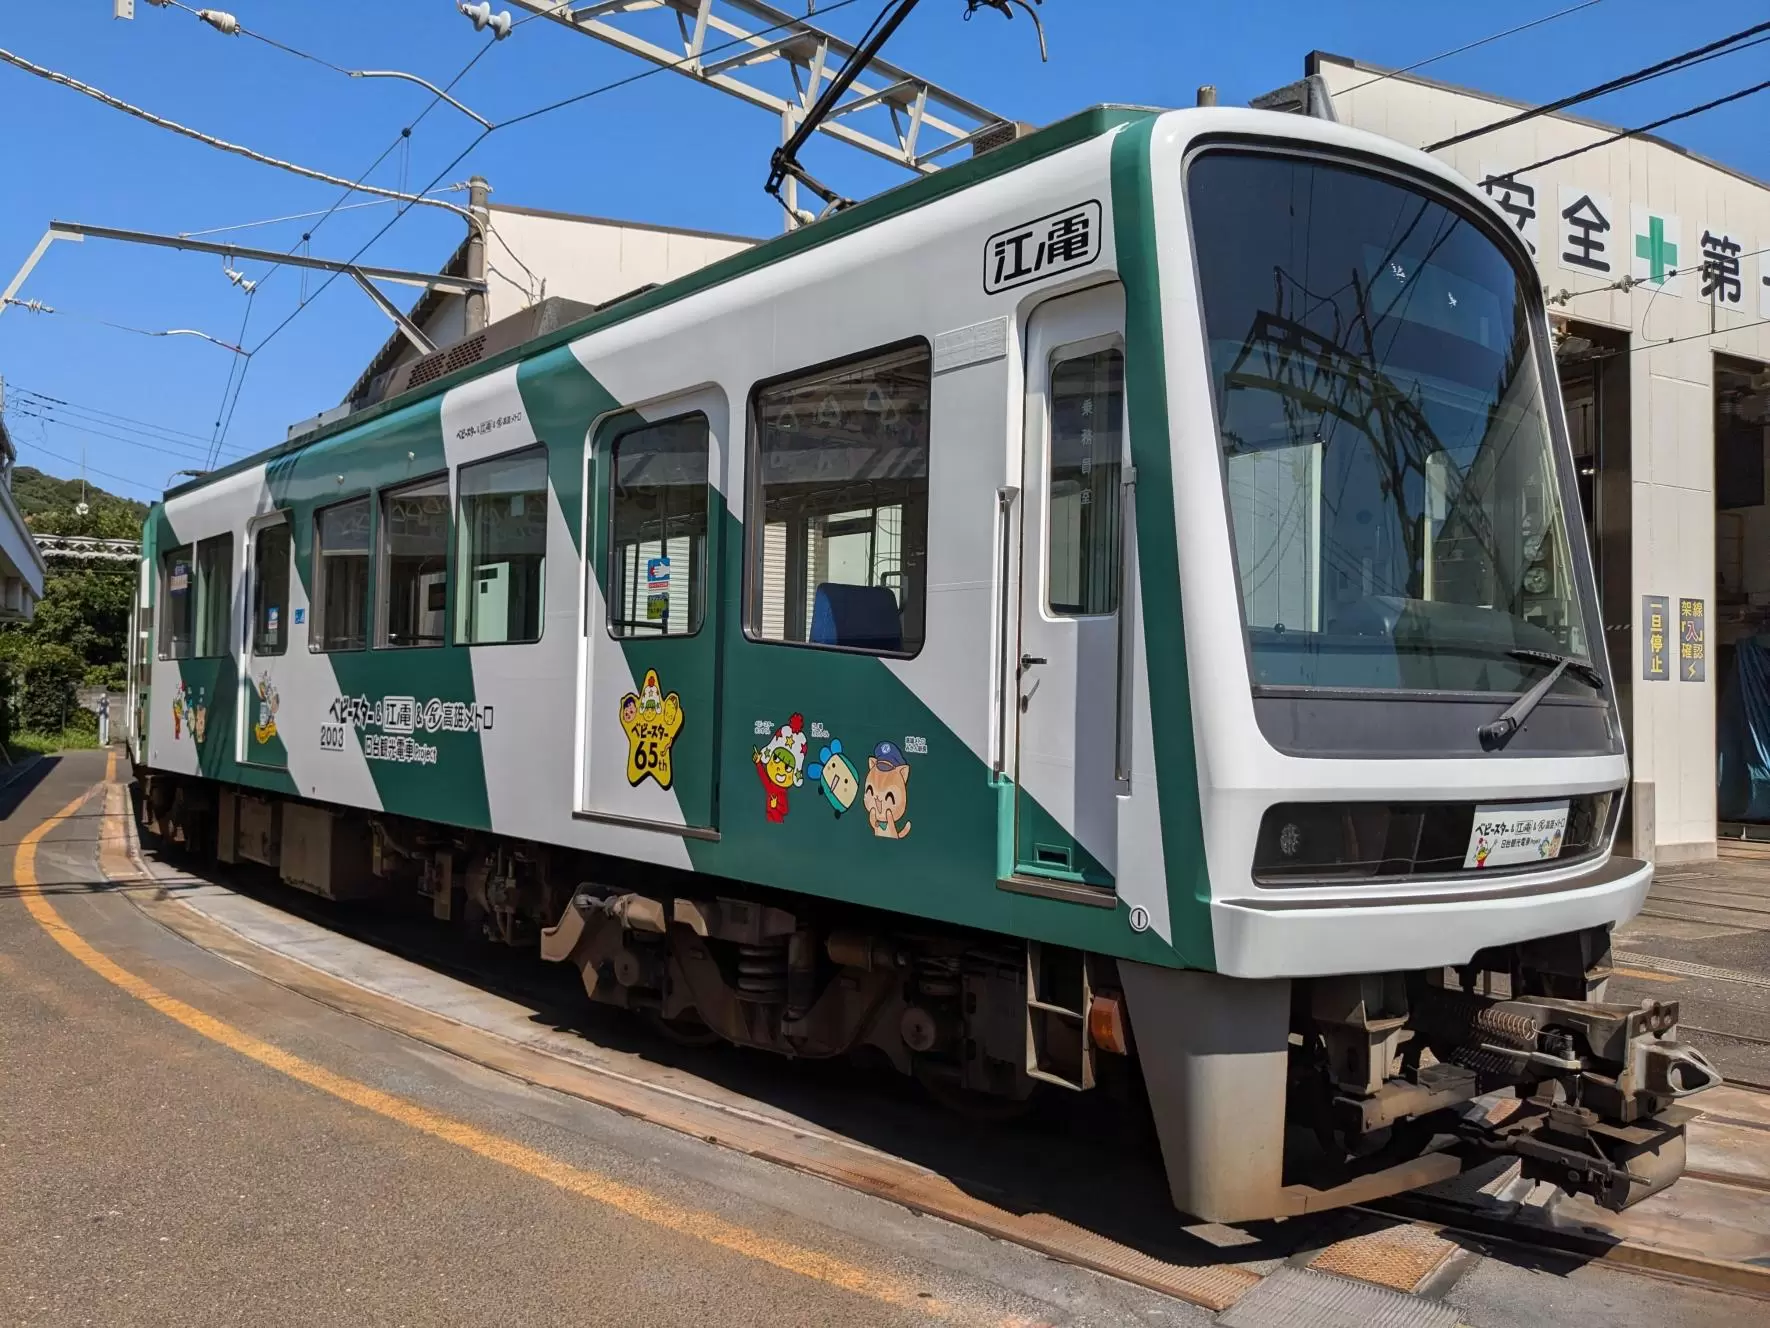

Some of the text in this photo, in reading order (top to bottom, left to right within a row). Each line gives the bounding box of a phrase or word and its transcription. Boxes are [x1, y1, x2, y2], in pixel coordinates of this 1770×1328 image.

[1081, 398, 1094, 505] 乗務員室
[1681, 600, 1704, 617] 架線
[1650, 603, 1664, 673] 一旦停止
[1681, 643, 1704, 659] 確認
[320, 726, 344, 748] 2003
[631, 722, 669, 742] ベビースター
